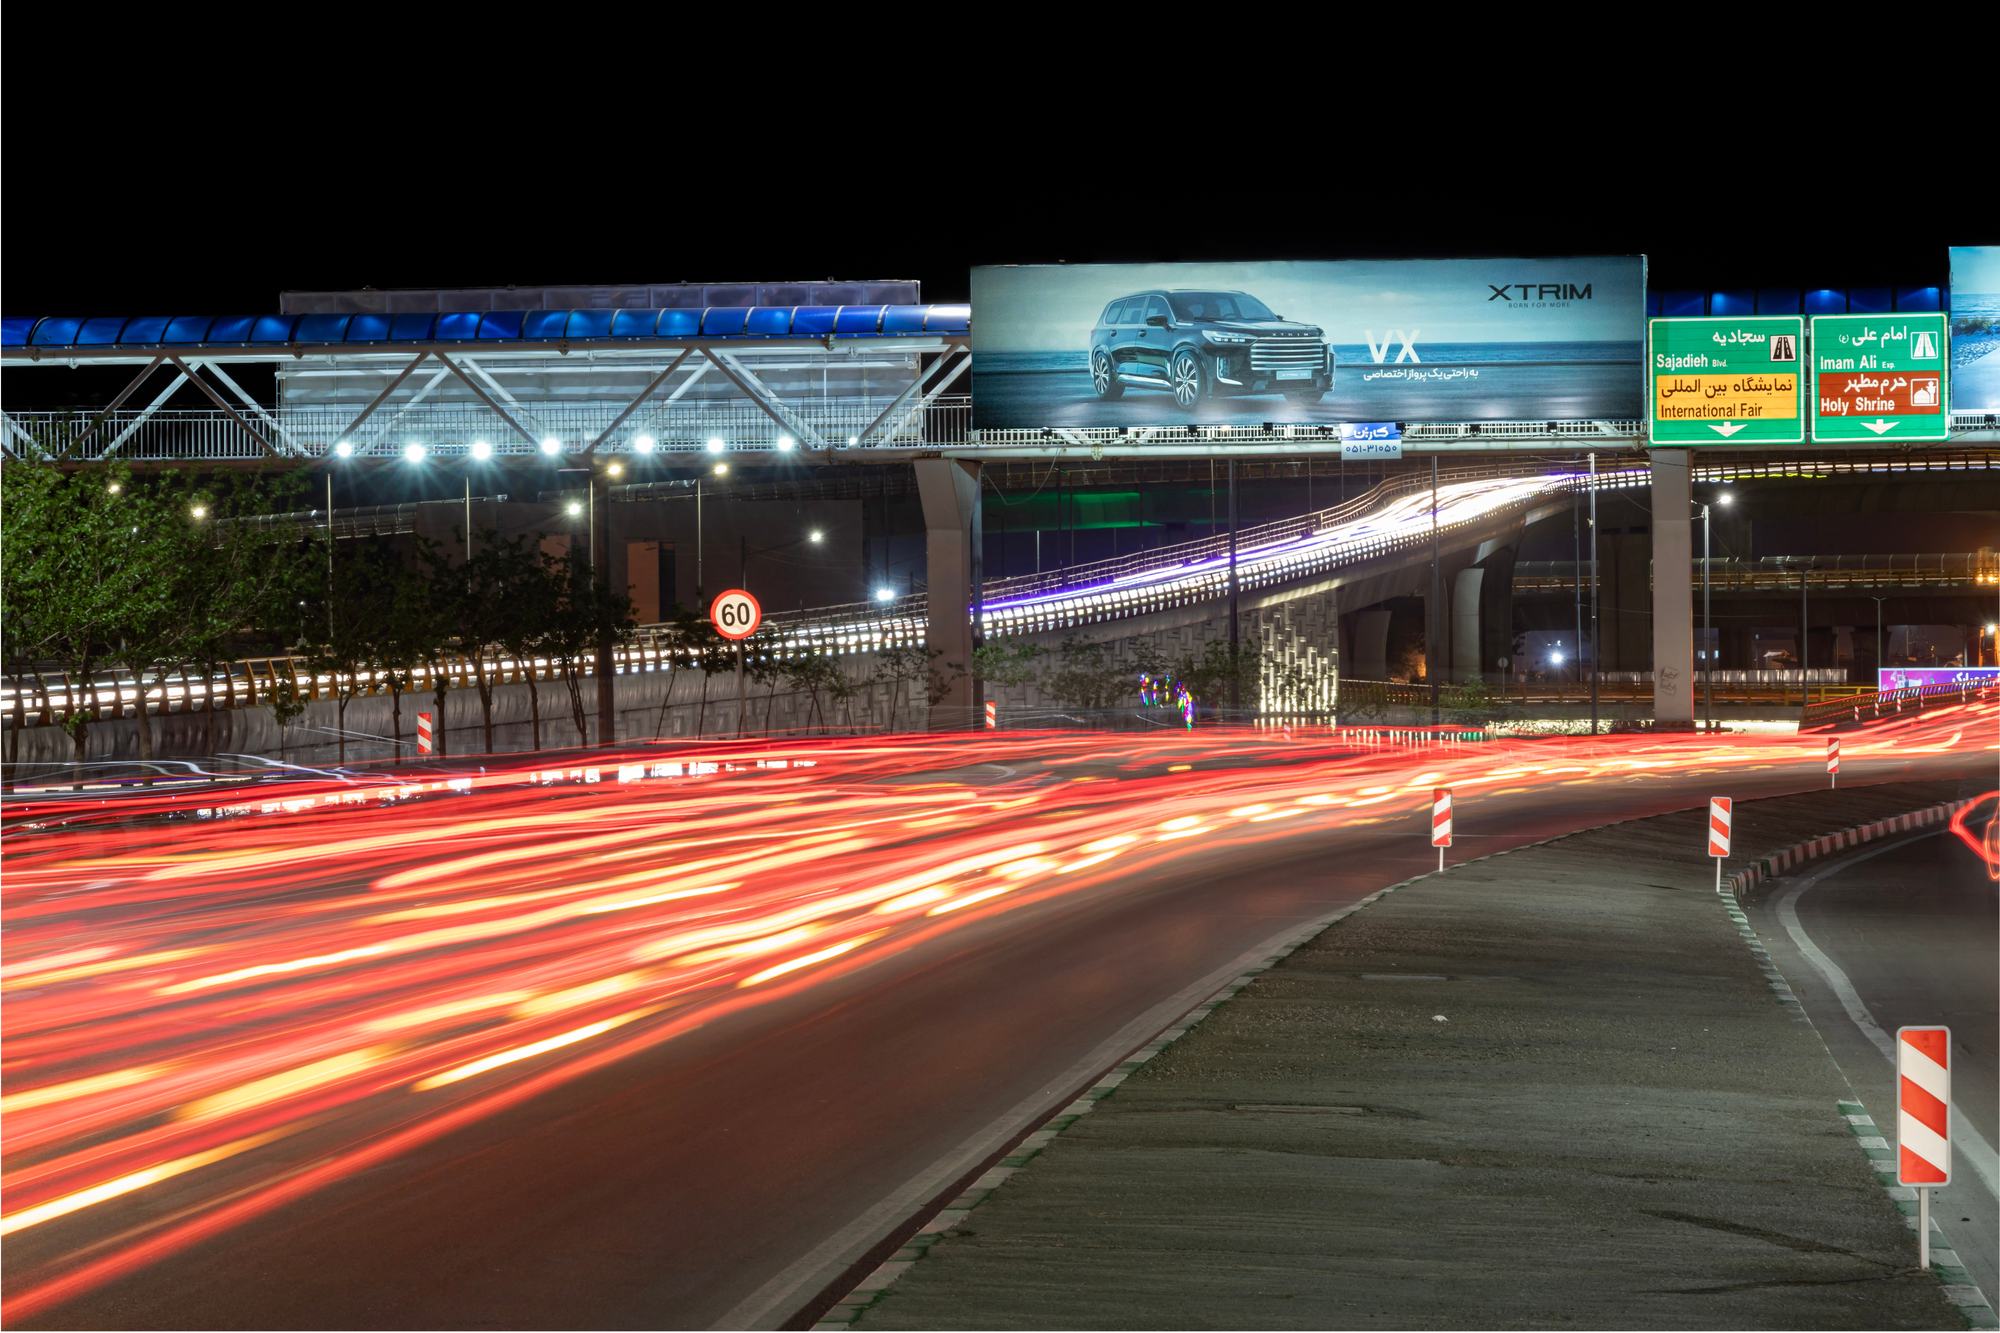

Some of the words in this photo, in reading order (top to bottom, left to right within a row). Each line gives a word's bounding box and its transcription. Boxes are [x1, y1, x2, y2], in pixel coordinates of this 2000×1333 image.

[1488, 283, 1592, 301] XTRIM
[1712, 329, 1766, 346] سجادیه
[1852, 327, 1877, 346] علی
[1881, 325, 1907, 348] امام
[1364, 329, 1421, 364] VX
[1656, 353, 1708, 371] Sajadieh
[1712, 359, 1728, 368] Blvd.
[1820, 355, 1854, 370] Imam
[1859, 355, 1877, 369] Ali
[1881, 361, 1895, 369] Exp.
[1363, 369, 1407, 381] اختصاصی
[1407, 368, 1427, 382] پرواز
[1428, 368, 1443, 381] یک
[1443, 368, 1469, 380] راحتی
[1469, 370, 1479, 379] به
[1661, 379, 1701, 398] المللی
[1705, 383, 1727, 398] بین
[1733, 376, 1793, 396] نمایشگاه
[1844, 374, 1879, 393] مطهر
[1880, 377, 1907, 395] حرم
[1661, 403, 1736, 418] International
[1740, 402, 1763, 417] Fair
[1820, 397, 1849, 416] Holy
[1855, 396, 1895, 411] Shrine
[721, 602, 750, 627] 60
